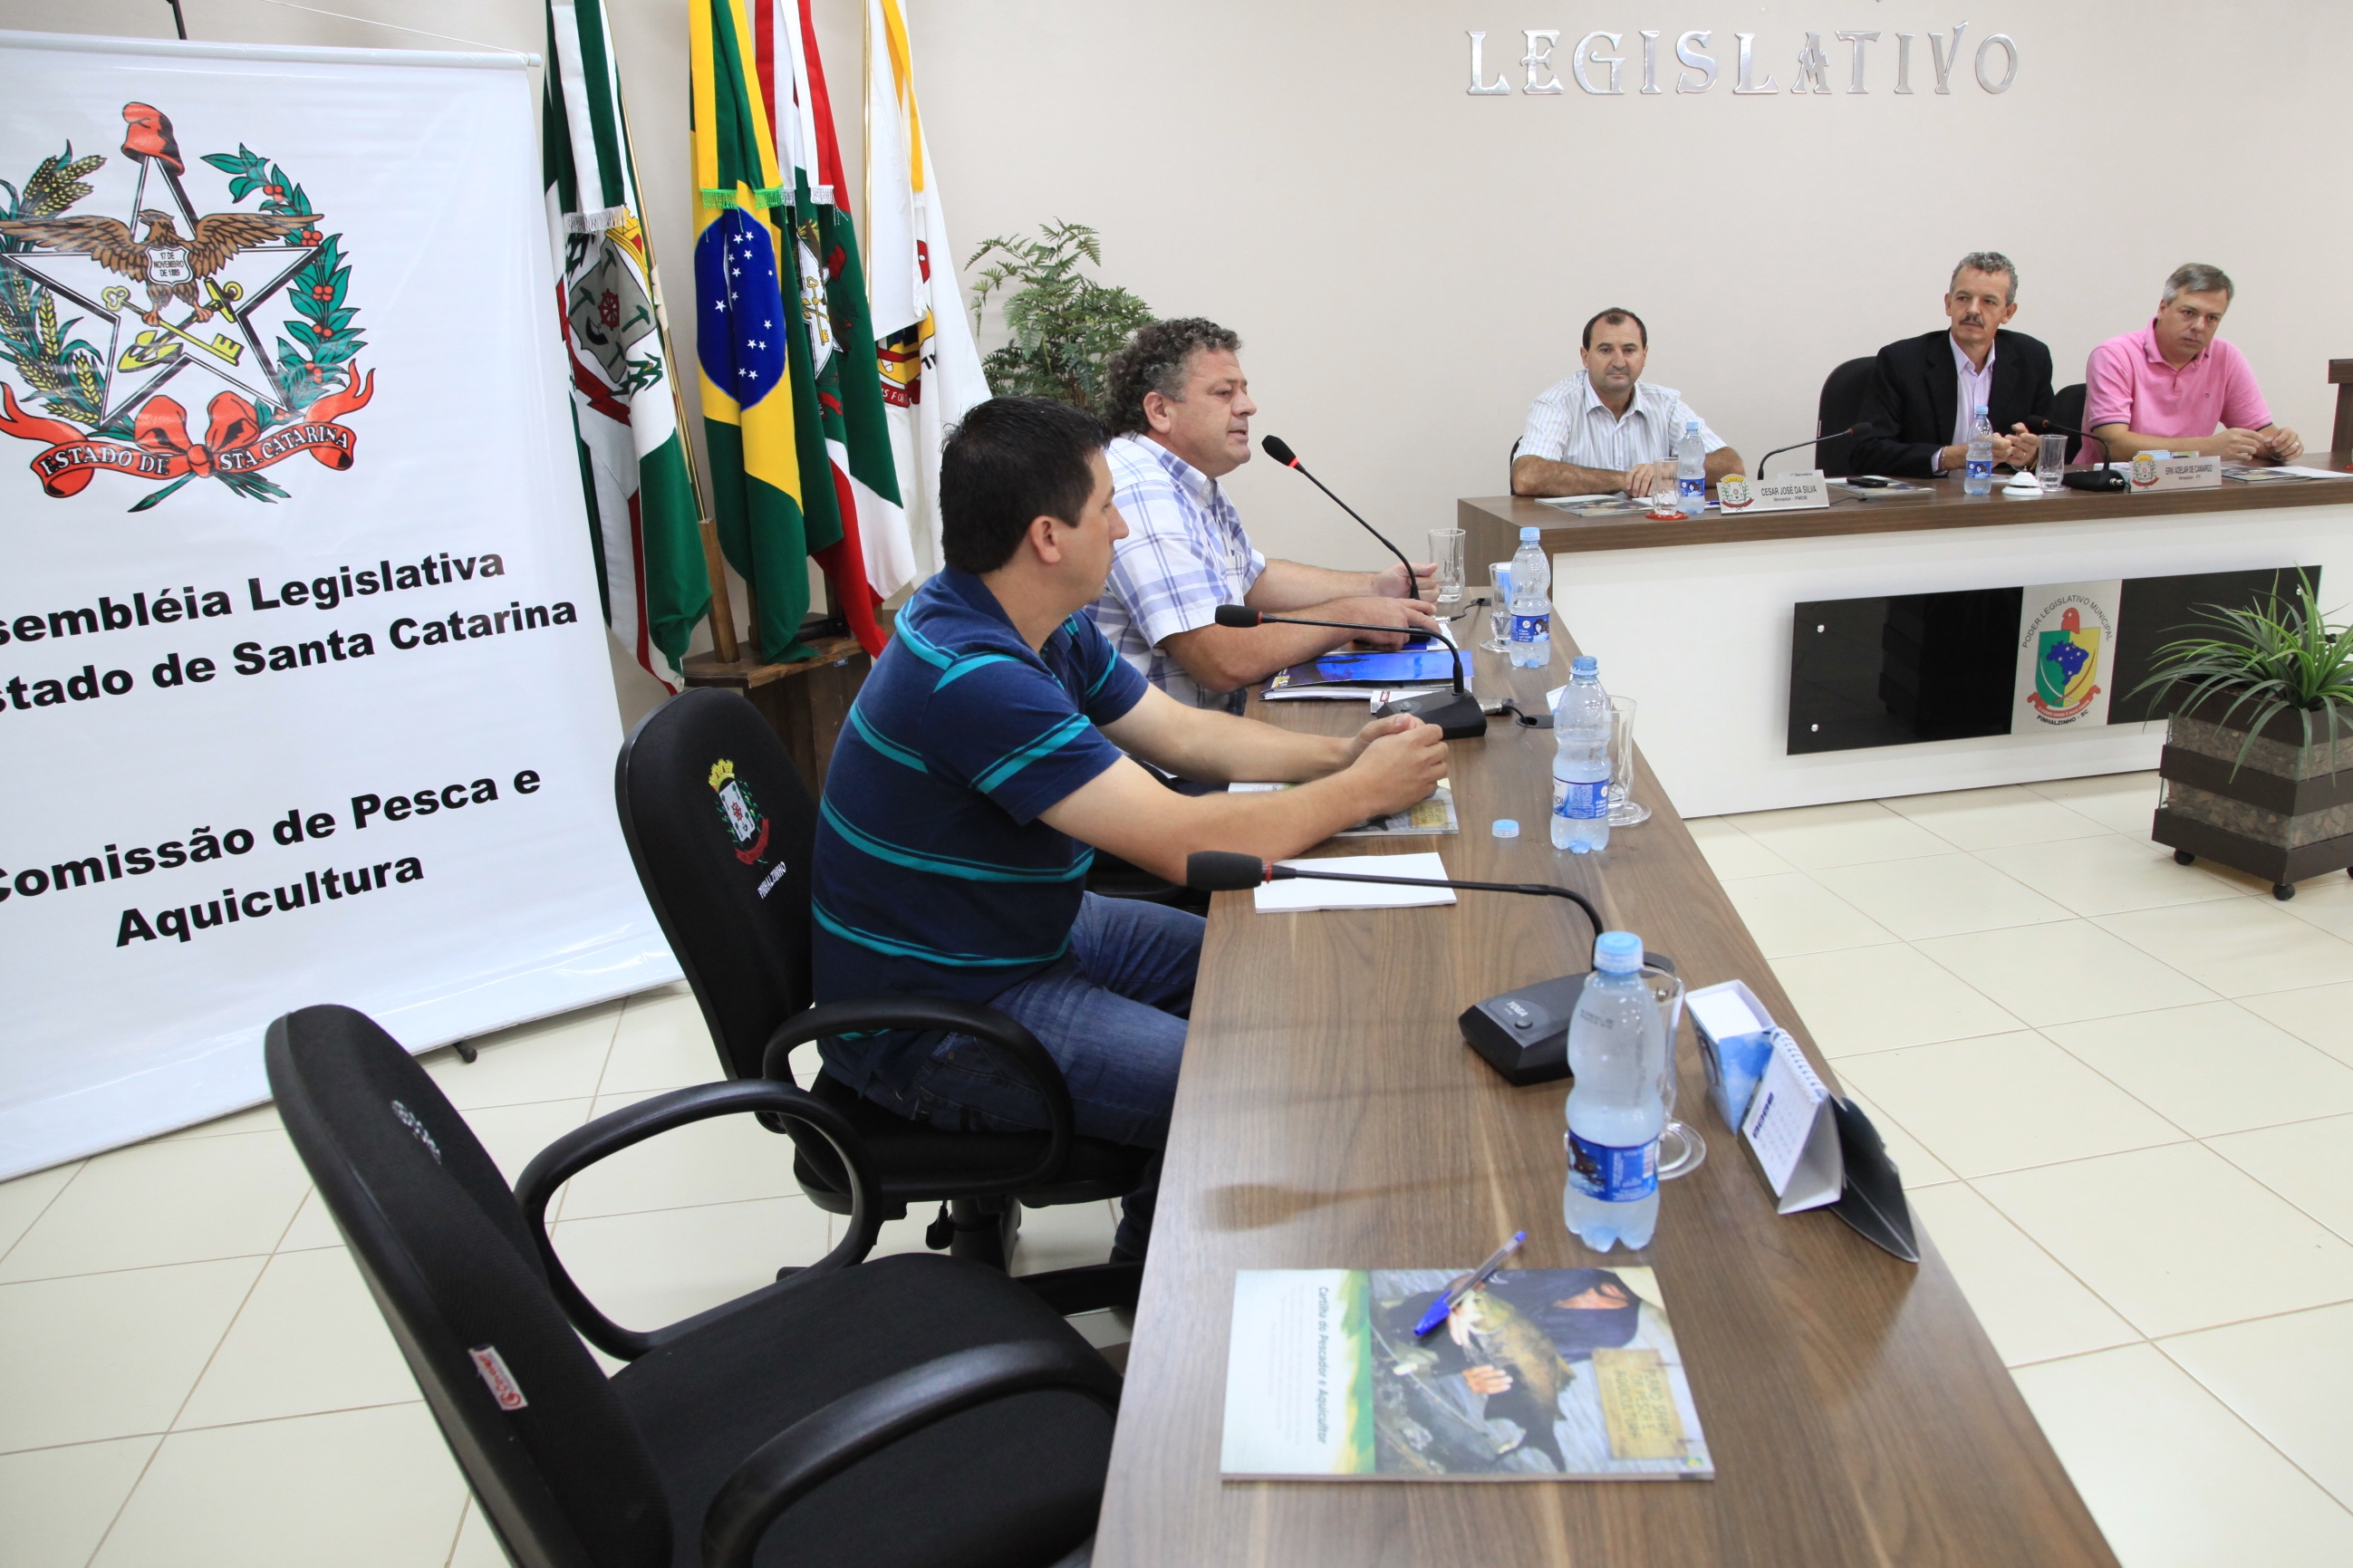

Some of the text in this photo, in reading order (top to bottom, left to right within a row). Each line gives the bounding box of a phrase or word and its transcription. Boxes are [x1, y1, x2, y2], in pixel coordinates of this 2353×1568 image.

[1465, 21, 2019, 95] LEGISLATIVO
[153, 260, 184, 268] NOVEMBRO
[159, 268, 169, 276] DE
[167, 252, 175, 260] DE
[41, 447, 170, 477] ESTADO DE
[2194, 465, 2213, 473] CAMARGO
[1760, 485, 1818, 496] CESAR JOSÉ DA SILVA
[247, 552, 506, 612] Legislativa
[2021, 594, 2113, 649] PODER LEGISLATIVO MUNICIPAL
[0, 600, 579, 714] tado de Santa Catarina
[2036, 714, 2077, 726] PINHALZINHO
[2080, 708, 2089, 717] SC
[273, 809, 337, 848] de
[351, 777, 499, 831] Pesca
[513, 770, 542, 795] e
[116, 855, 425, 948] Aquicultura
[1318, 1286, 1329, 1319] Cartilha
[1318, 1321, 1327, 1332] do
[1318, 1334, 1329, 1378] Pescador
[1316, 1388, 1328, 1445] Aquicultor
